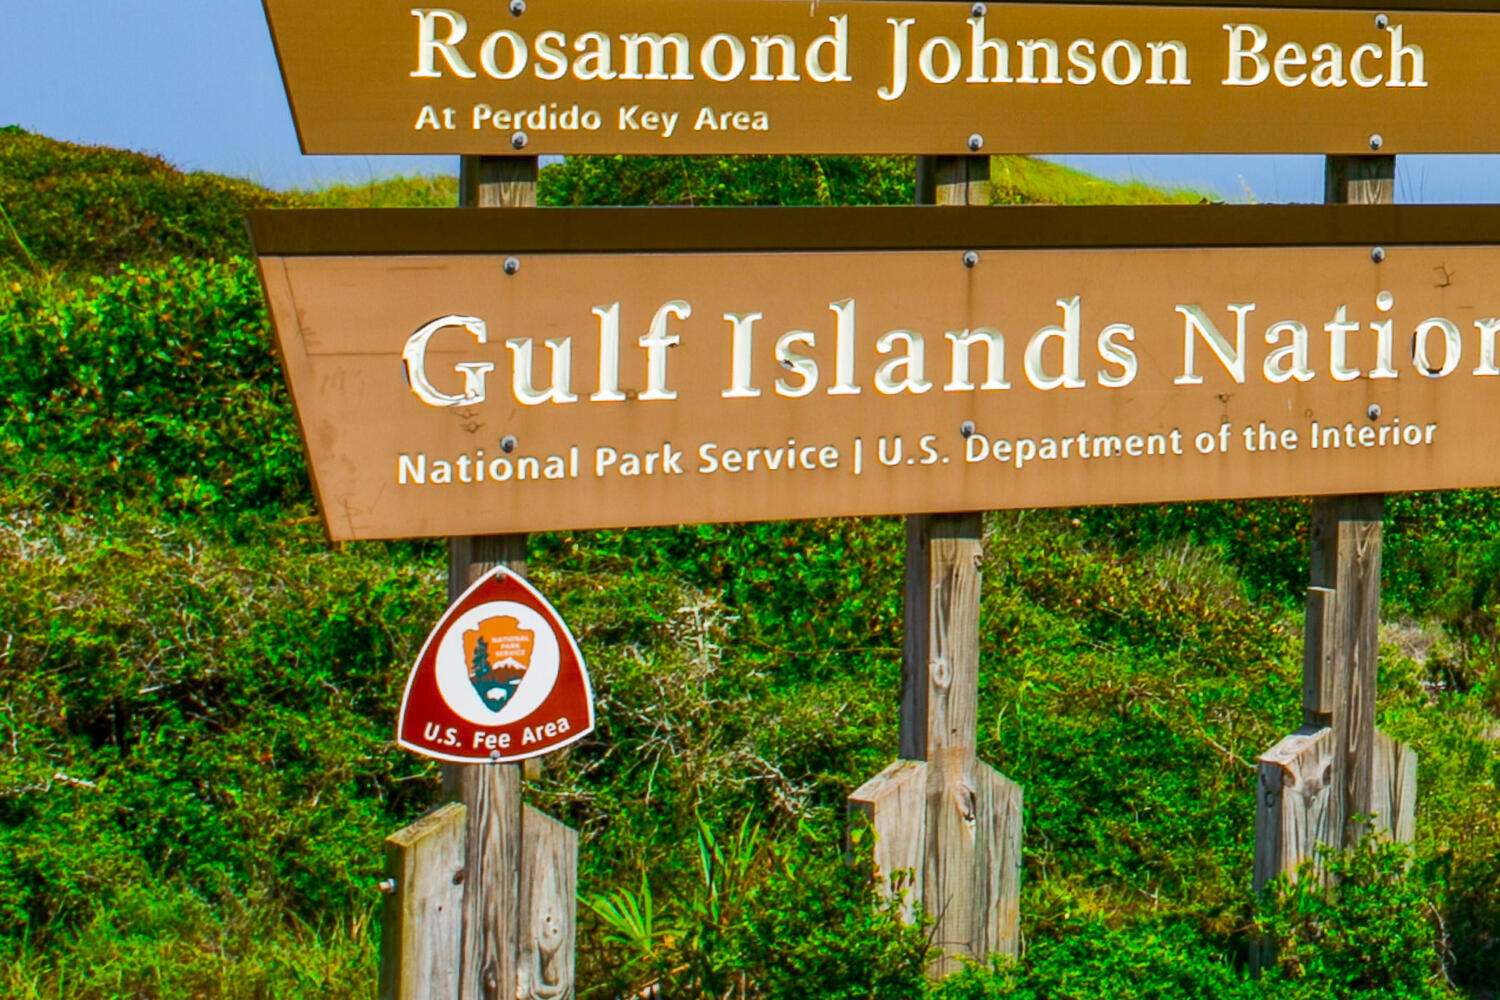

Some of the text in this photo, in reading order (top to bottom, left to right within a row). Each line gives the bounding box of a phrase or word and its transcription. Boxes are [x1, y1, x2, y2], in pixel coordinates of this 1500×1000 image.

[409, 8, 1428, 101] Rosamond Johnson Beach
[414, 102, 769, 137] At Perdido Key Area
[401, 300, 692, 407] Gulf
[721, 294, 1138, 398] Islands
[397, 446, 579, 485] National
[595, 442, 683, 477] Park
[698, 440, 839, 474] Service
[877, 435, 950, 467] U.S.
[964, 426, 1183, 468] Department
[1195, 423, 1232, 454] of
[1243, 420, 1299, 452] the
[1311, 417, 1437, 450] Interior
[424, 717, 570, 749] U.S. Fee Area
